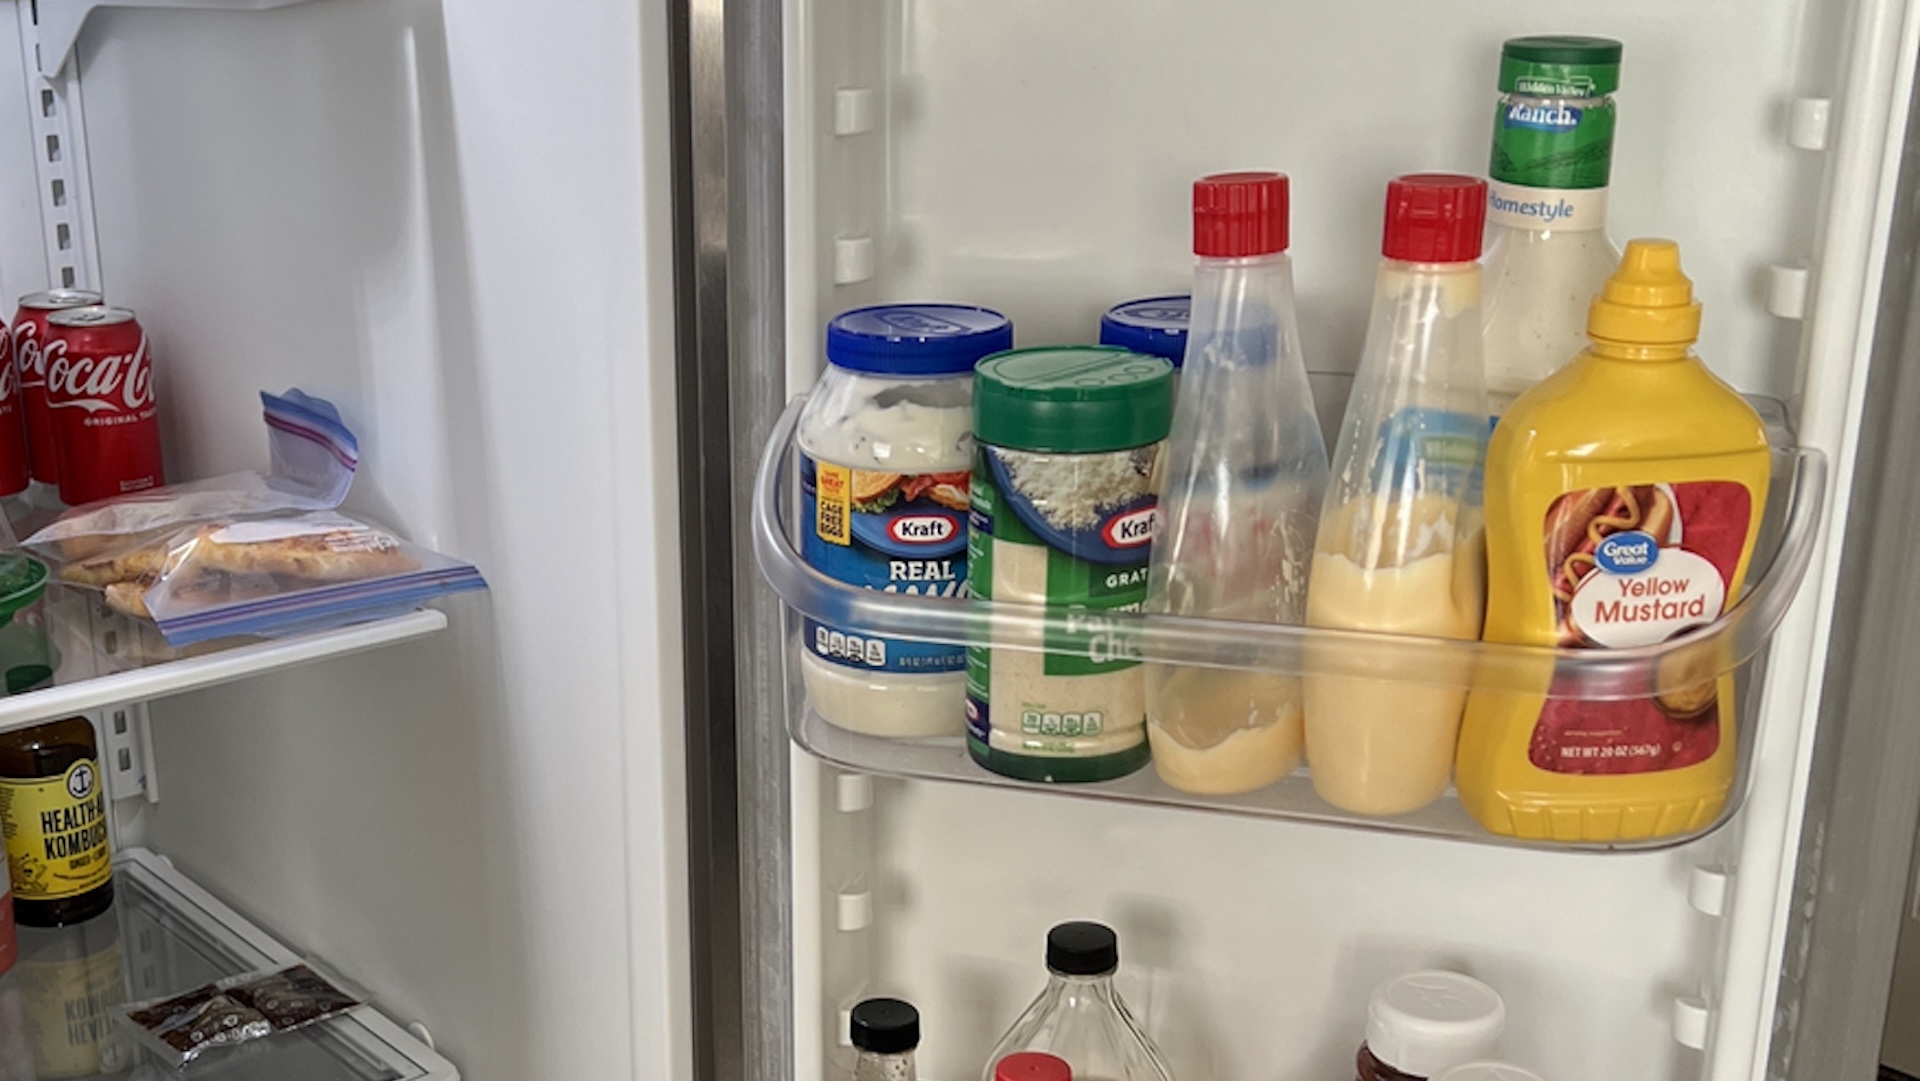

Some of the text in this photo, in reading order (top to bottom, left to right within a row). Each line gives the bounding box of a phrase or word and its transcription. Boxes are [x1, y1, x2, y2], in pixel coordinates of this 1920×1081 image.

[83, 415, 138, 427] ORIGINAL
[901, 521, 944, 537] Kraft
[1603, 541, 1650, 557] Great
[1613, 555, 1649, 566] Value
[889, 560, 957, 581] REAL
[1105, 567, 1149, 588] GRAT
[1618, 577, 1690, 598] Yellow
[1594, 594, 1705, 623] Mustard
[1561, 747, 1581, 758] NET
